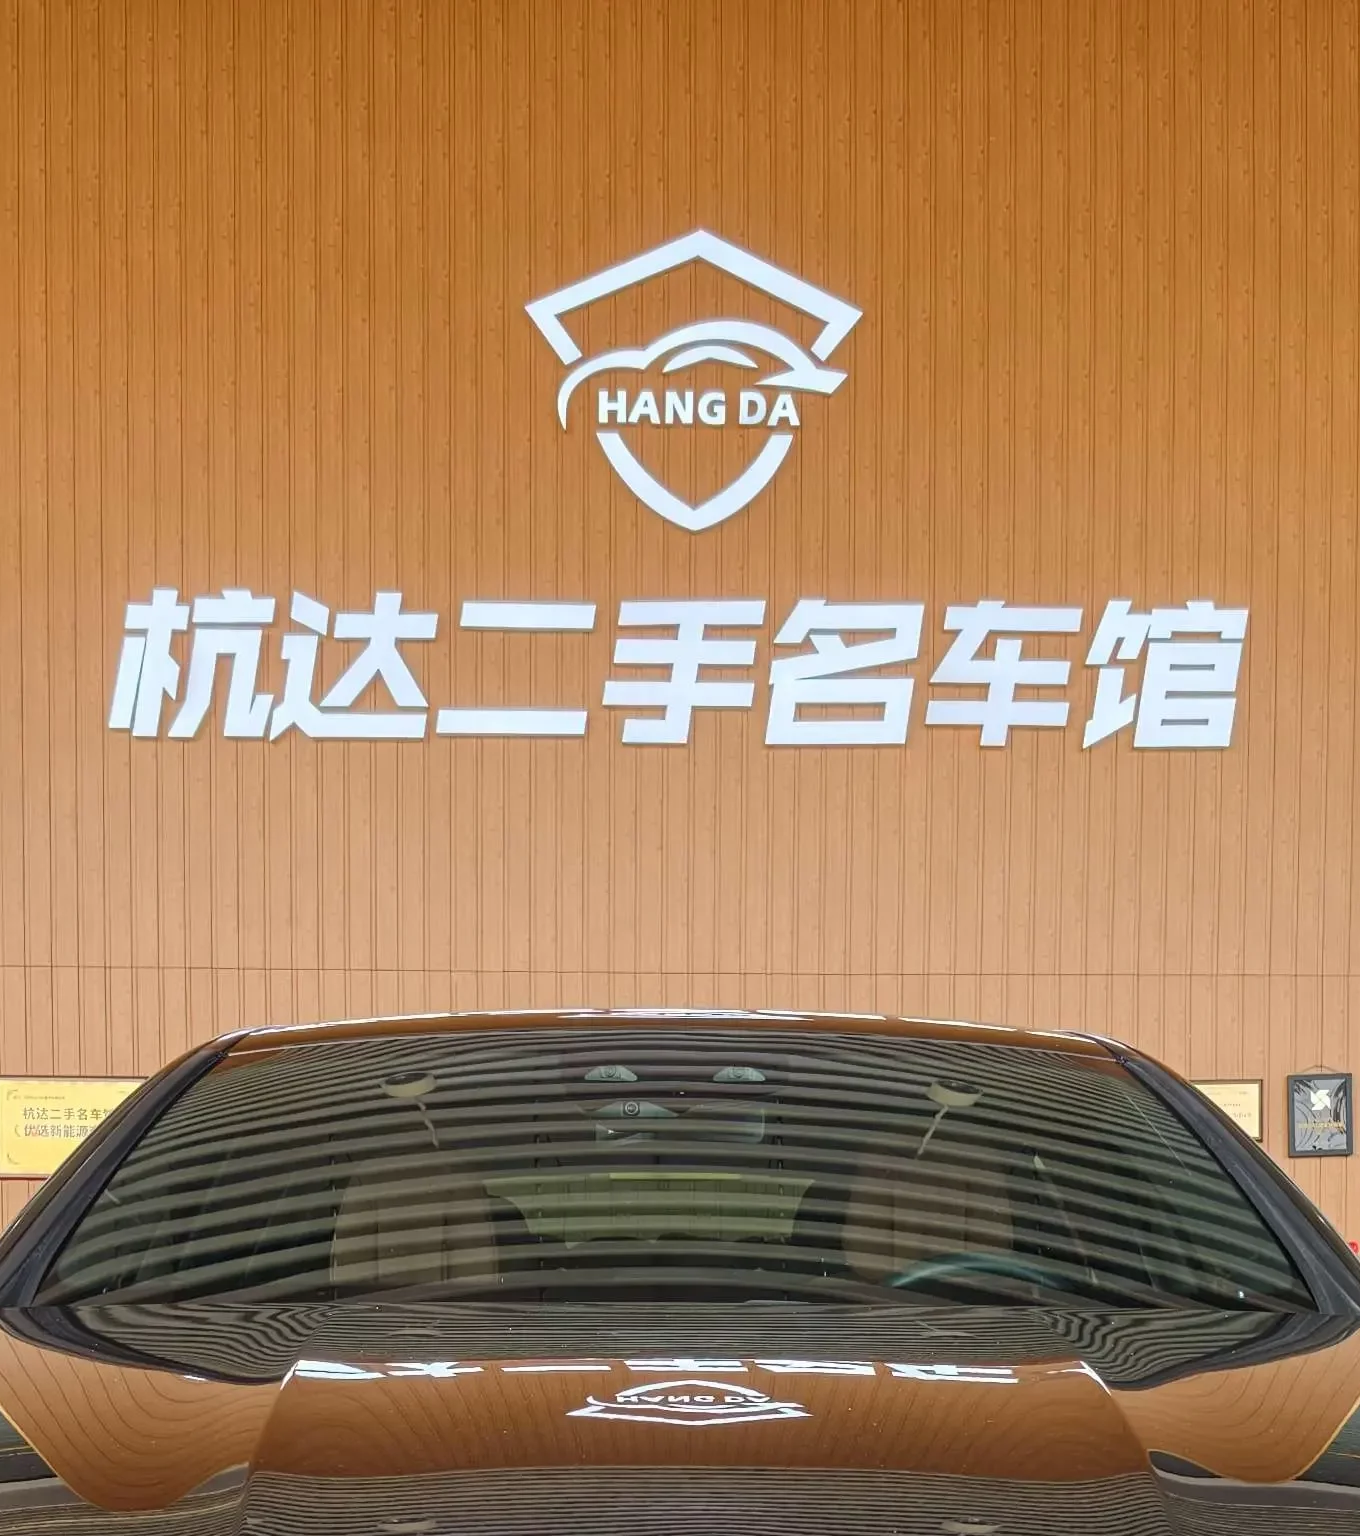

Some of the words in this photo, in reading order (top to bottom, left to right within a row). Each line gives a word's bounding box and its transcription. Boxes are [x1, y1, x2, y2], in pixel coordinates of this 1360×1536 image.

[598, 390, 726, 425] HANG
[738, 391, 801, 427] DA
[108, 589, 1249, 749] 杭达二手名车馆
